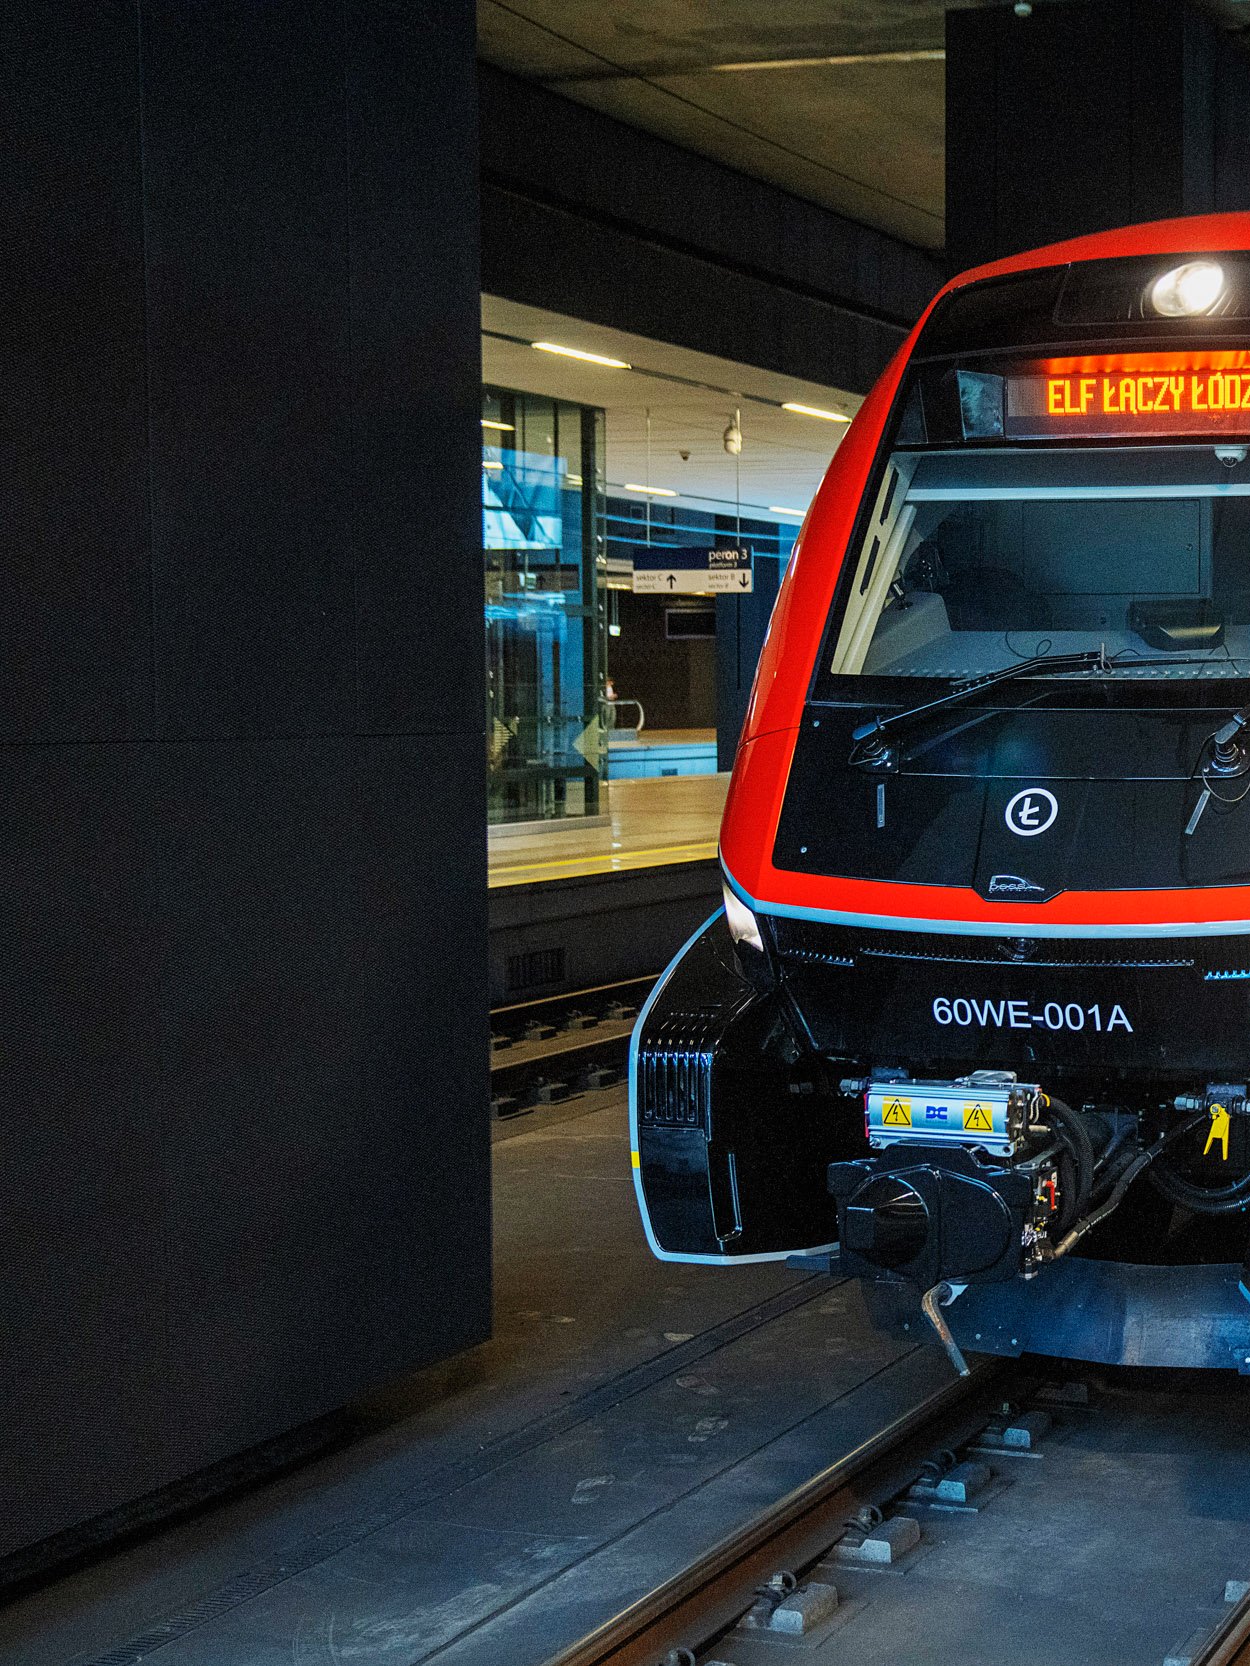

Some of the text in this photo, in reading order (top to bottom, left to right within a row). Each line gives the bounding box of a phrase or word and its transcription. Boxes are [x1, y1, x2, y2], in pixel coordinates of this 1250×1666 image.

[1048, 379, 1097, 414] ELF
[1103, 376, 1185, 415] ŁĄCZY
[708, 549, 748, 562] peron 3
[932, 997, 1134, 1033] 60WE-001A
